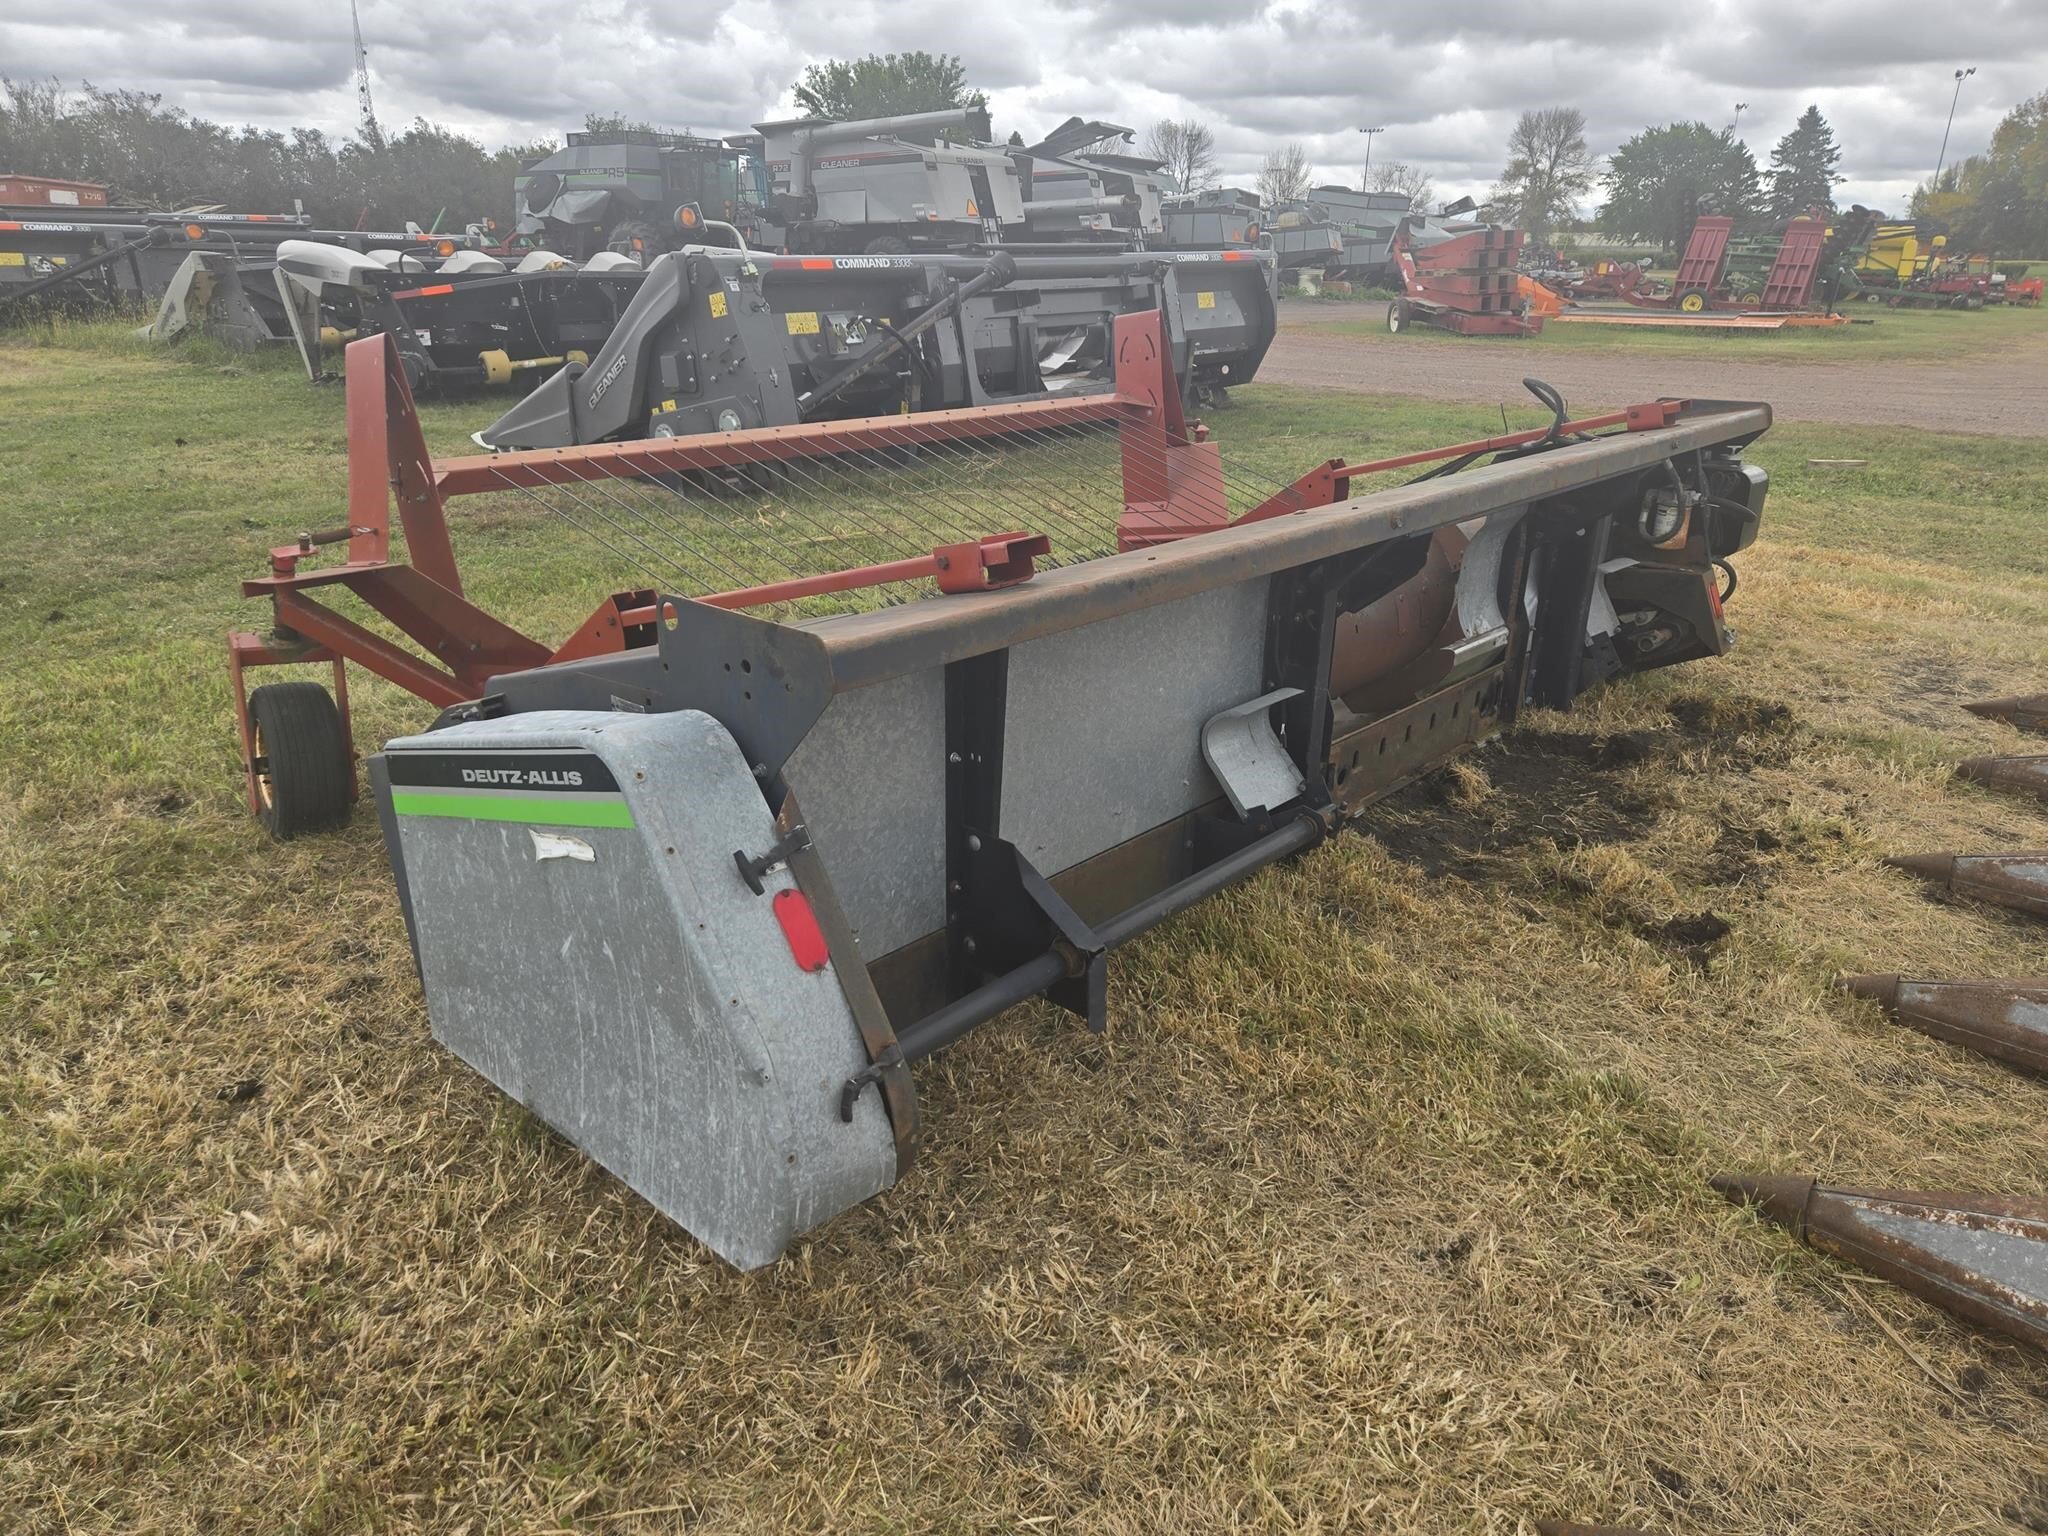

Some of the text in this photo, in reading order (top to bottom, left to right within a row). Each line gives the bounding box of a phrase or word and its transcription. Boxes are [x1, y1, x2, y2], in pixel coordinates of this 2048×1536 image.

[821, 159, 860, 169] GLEANER
[836, 257, 890, 268] COMMAND
[1177, 253, 1209, 262] COMMAND
[589, 354, 627, 409] GLEANER
[462, 769, 583, 786] DEUTZ-ALLIS
